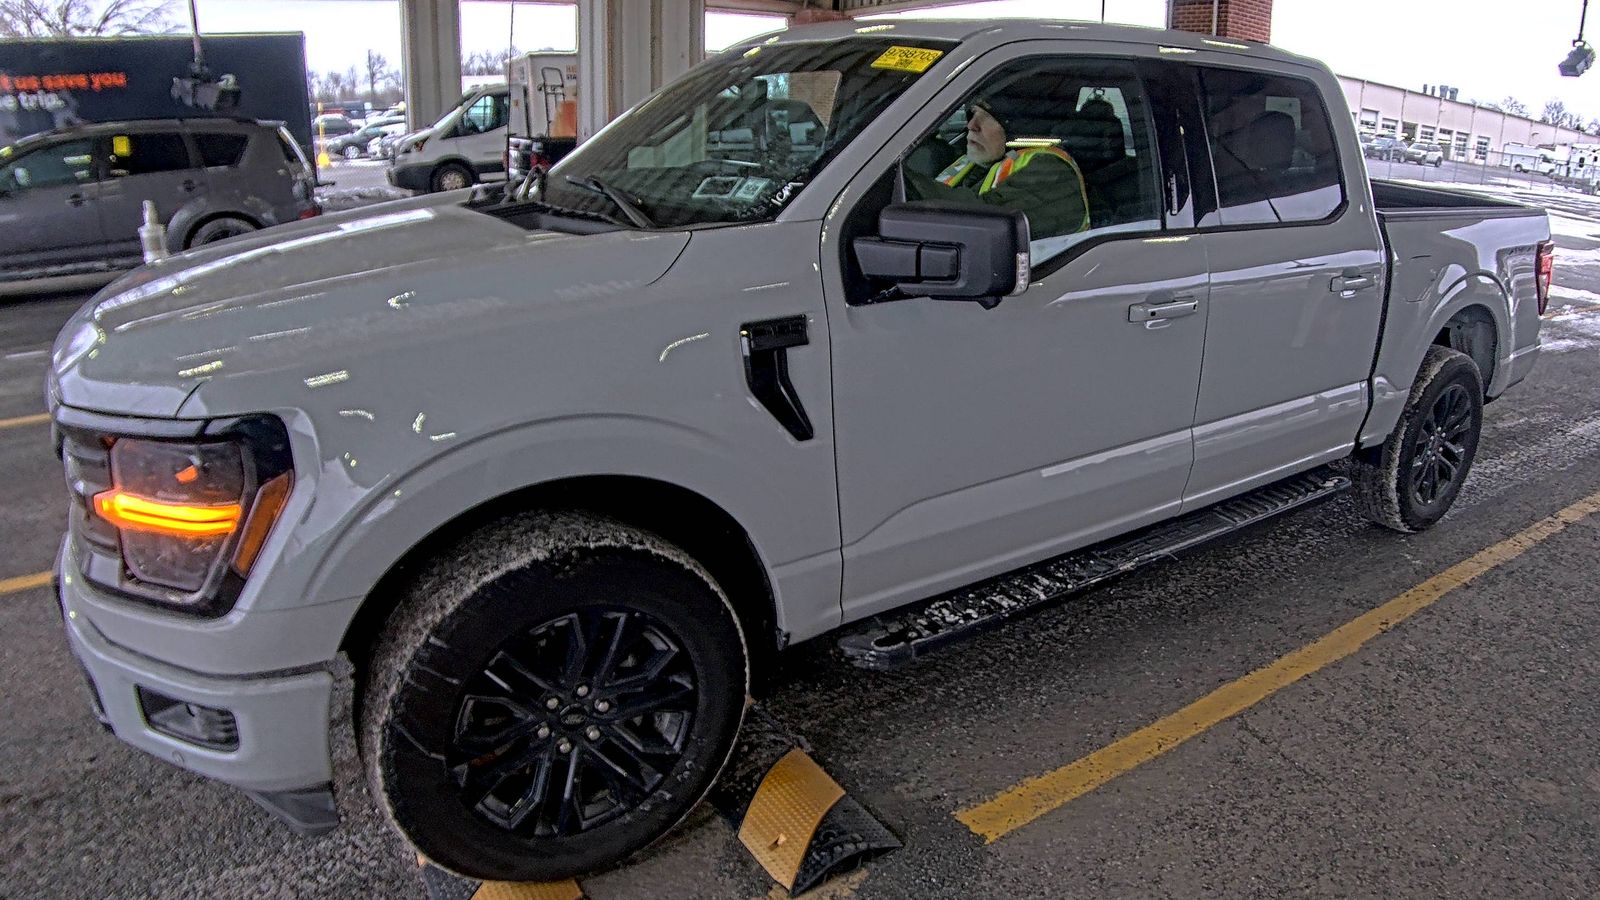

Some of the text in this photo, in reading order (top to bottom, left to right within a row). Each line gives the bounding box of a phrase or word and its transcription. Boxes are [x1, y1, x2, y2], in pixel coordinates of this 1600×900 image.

[15, 76, 38, 90] us
[42, 75, 88, 90] save
[91, 73, 126, 91] you
